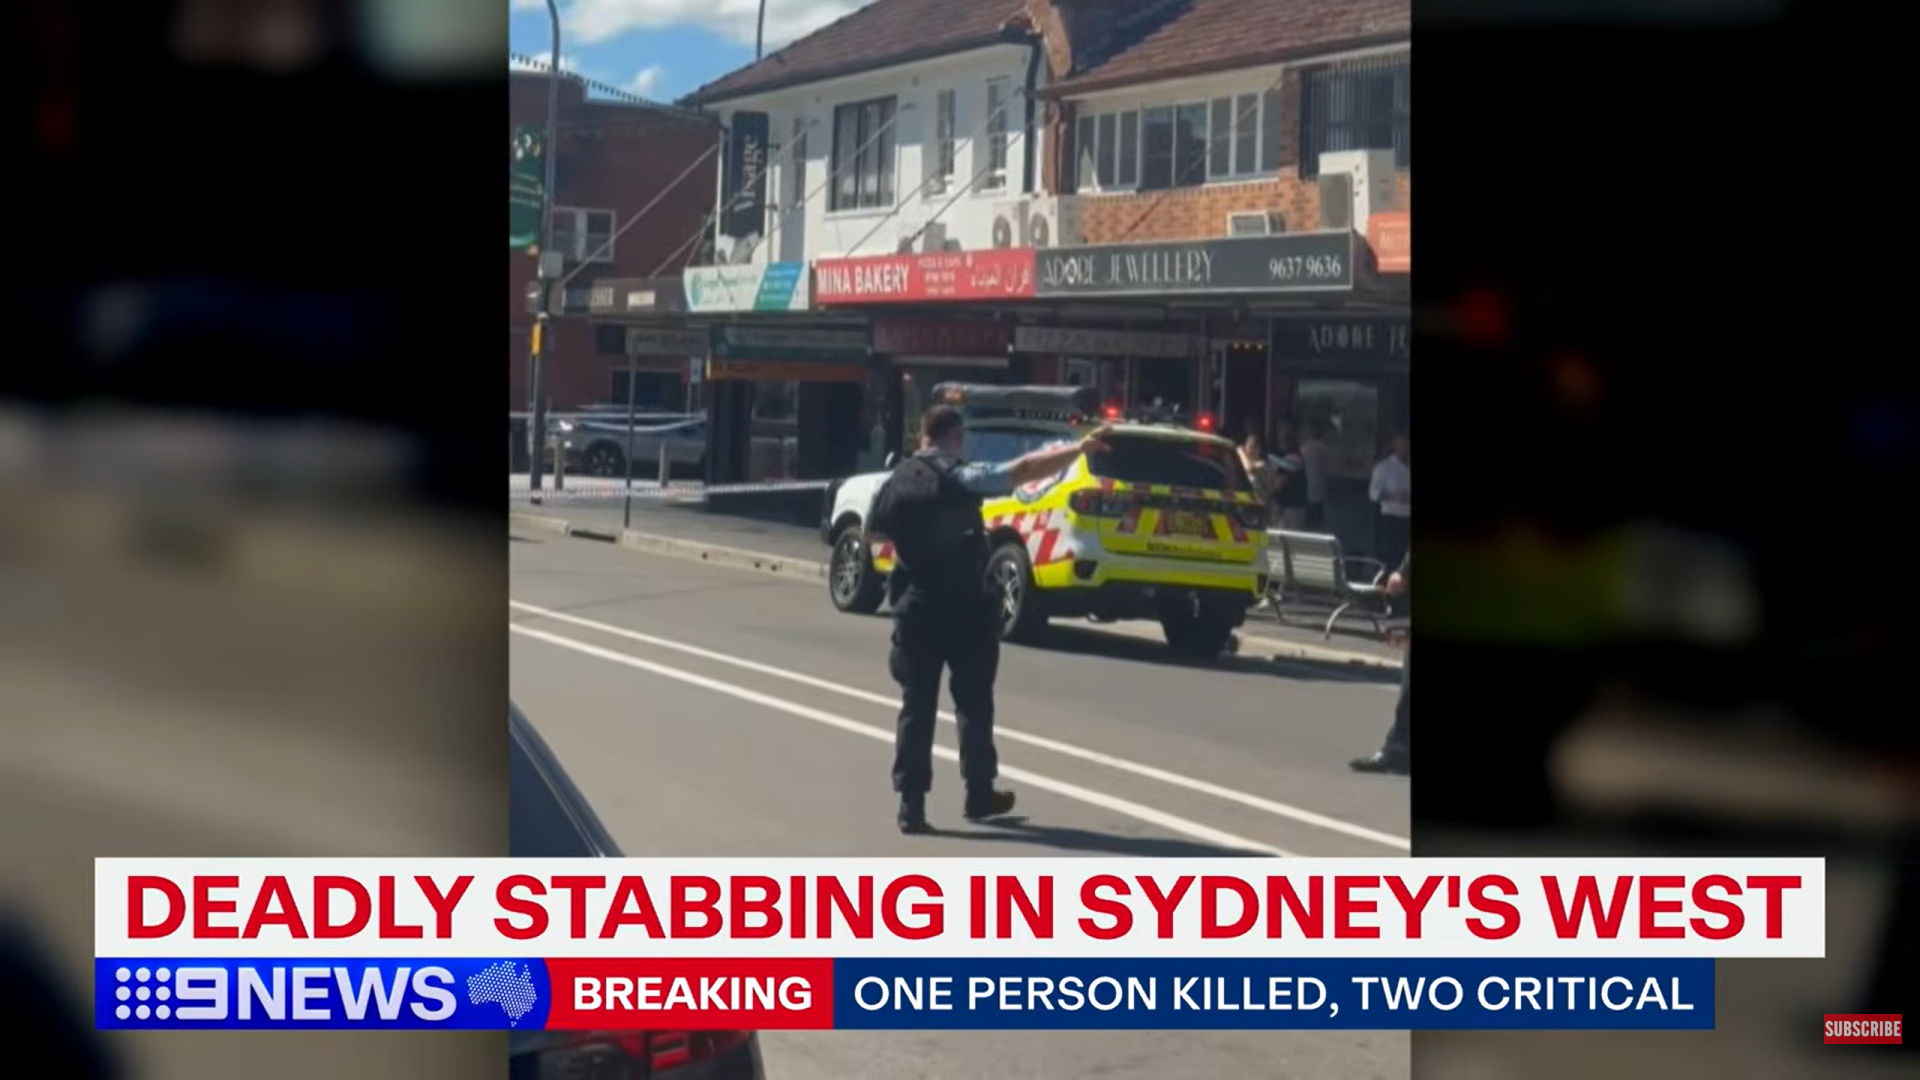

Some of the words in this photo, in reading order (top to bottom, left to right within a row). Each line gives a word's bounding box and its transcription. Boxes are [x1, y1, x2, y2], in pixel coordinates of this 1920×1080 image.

[817, 266, 851, 294] MINA
[855, 263, 909, 294] BAKERY
[1044, 256, 1095, 286] ADORE
[1109, 251, 1214, 284] JEWELLERY
[1269, 258, 1302, 281] 9637
[1306, 255, 1342, 279] 9636
